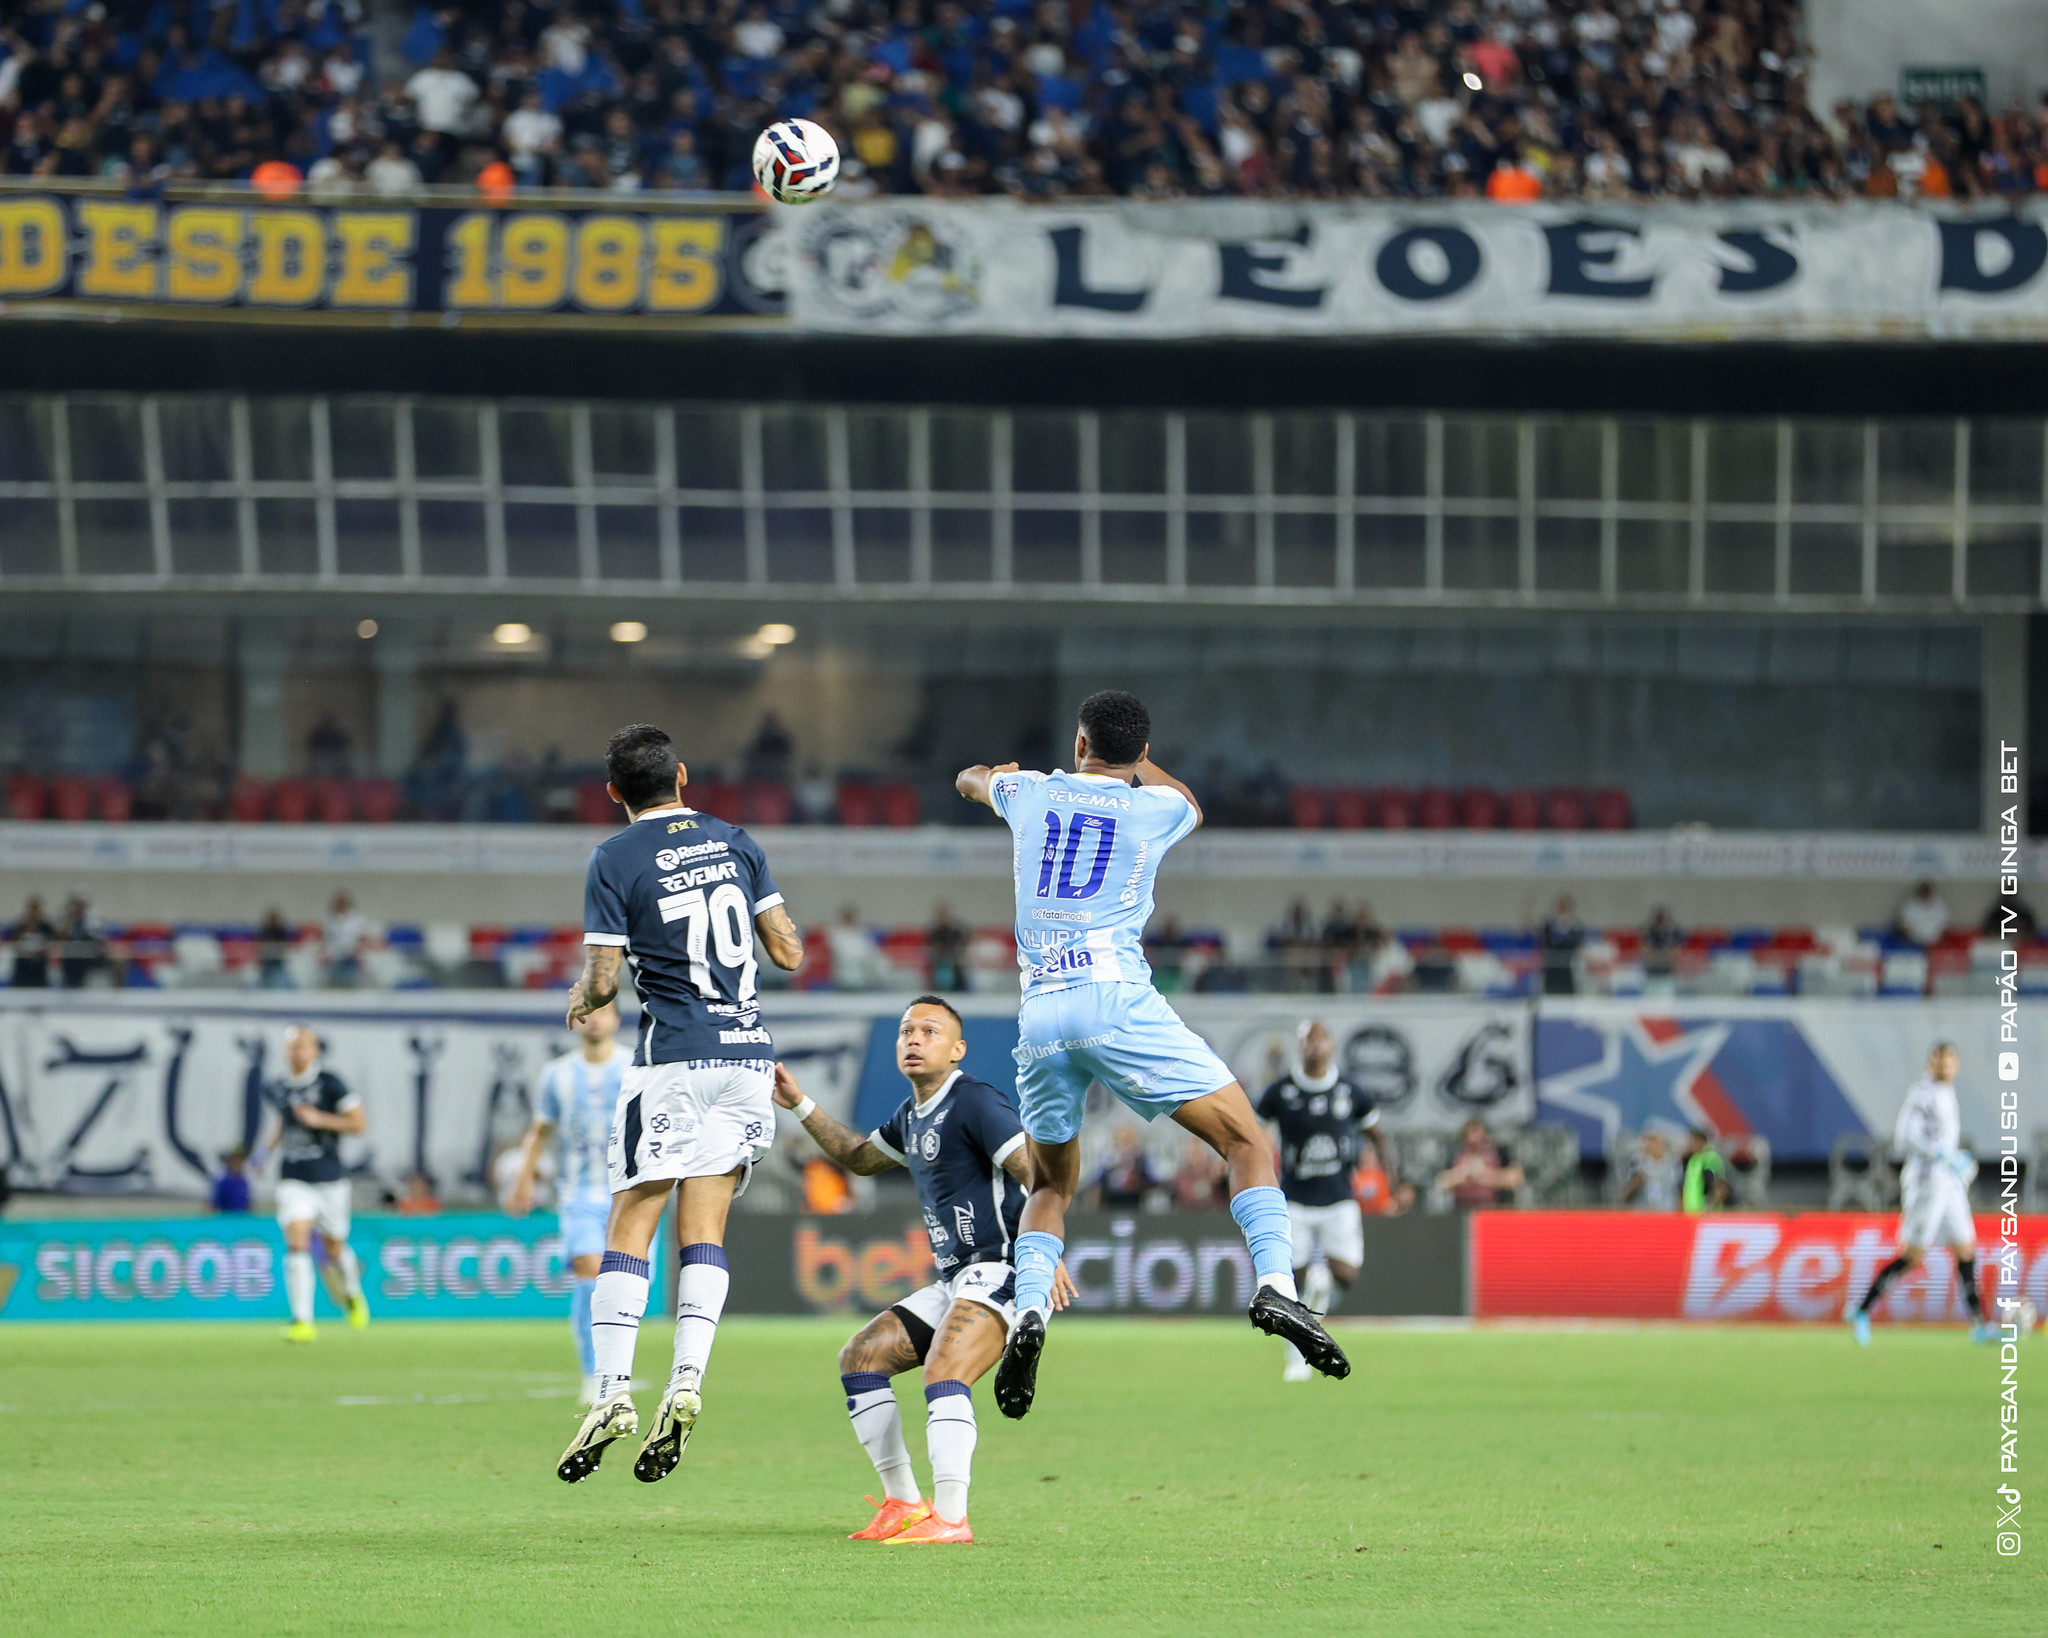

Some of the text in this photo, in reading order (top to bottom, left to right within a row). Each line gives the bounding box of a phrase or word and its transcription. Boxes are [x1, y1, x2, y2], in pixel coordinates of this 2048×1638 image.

[0, 201, 723, 311] DESDE 1985
[1047, 789, 1133, 812] REVEMAR
[676, 840, 729, 860] Resolve
[1034, 808, 1120, 902] 10
[657, 861, 739, 893] REVEMAR
[1042, 909, 1092, 922] fatalmodel
[657, 883, 760, 1001] 79
[1032, 1030, 1118, 1060] UniCesumar
[952, 1201, 976, 1247] Zilmar
[36, 1242, 275, 1302] SICOOB
